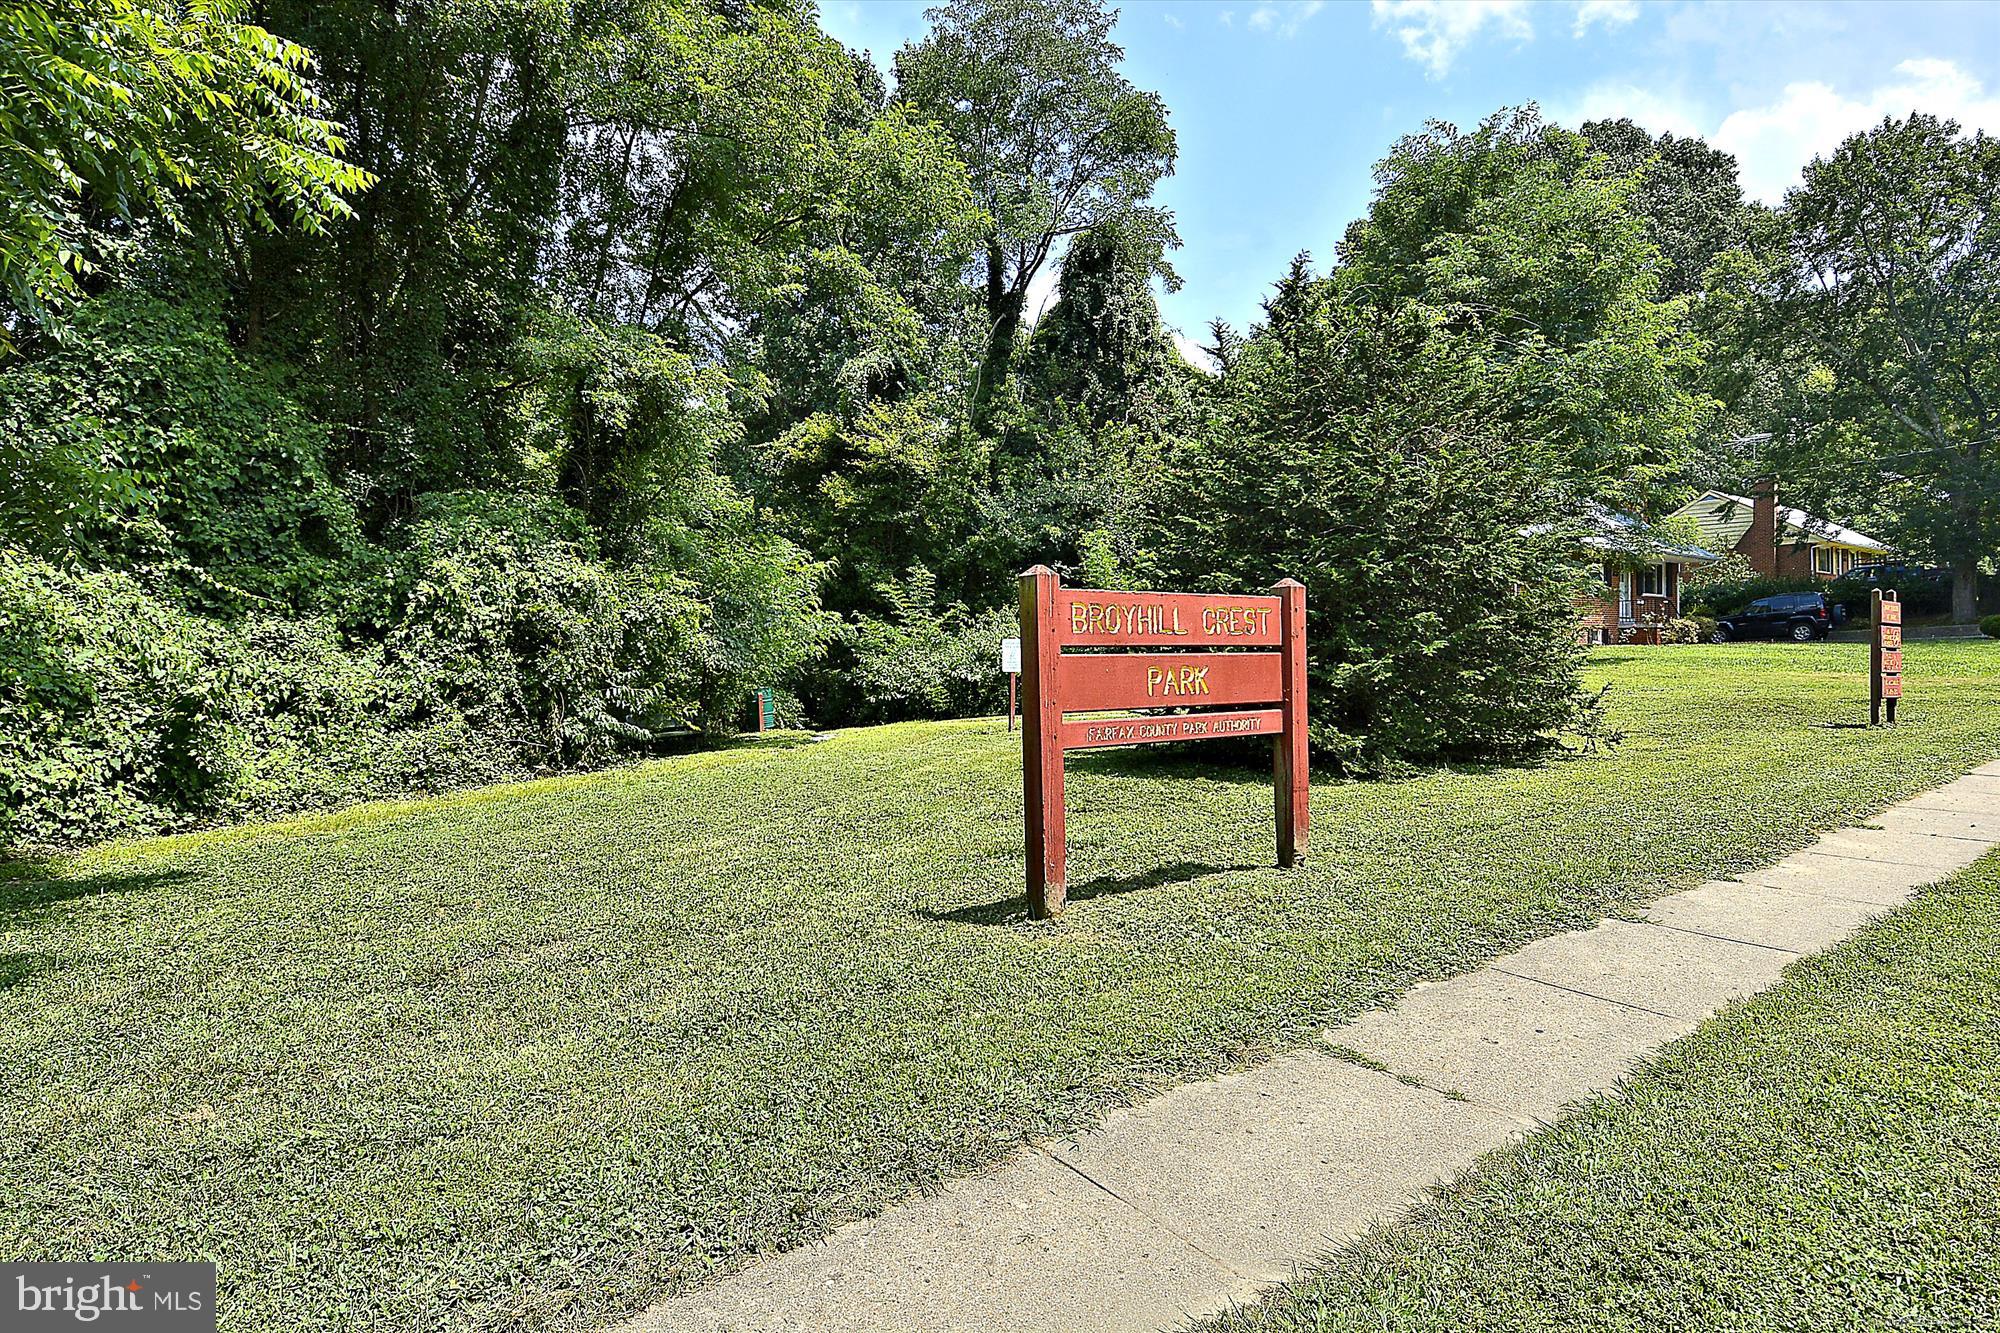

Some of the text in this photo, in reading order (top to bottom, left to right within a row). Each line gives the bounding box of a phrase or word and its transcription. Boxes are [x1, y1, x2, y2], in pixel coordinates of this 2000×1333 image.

[1071, 603, 1272, 635] BROYHILL CREST
[1147, 665, 1209, 696] PARK
[1088, 718, 1261, 742] FAIRFAX COUNTY PARK AUTHORITY
